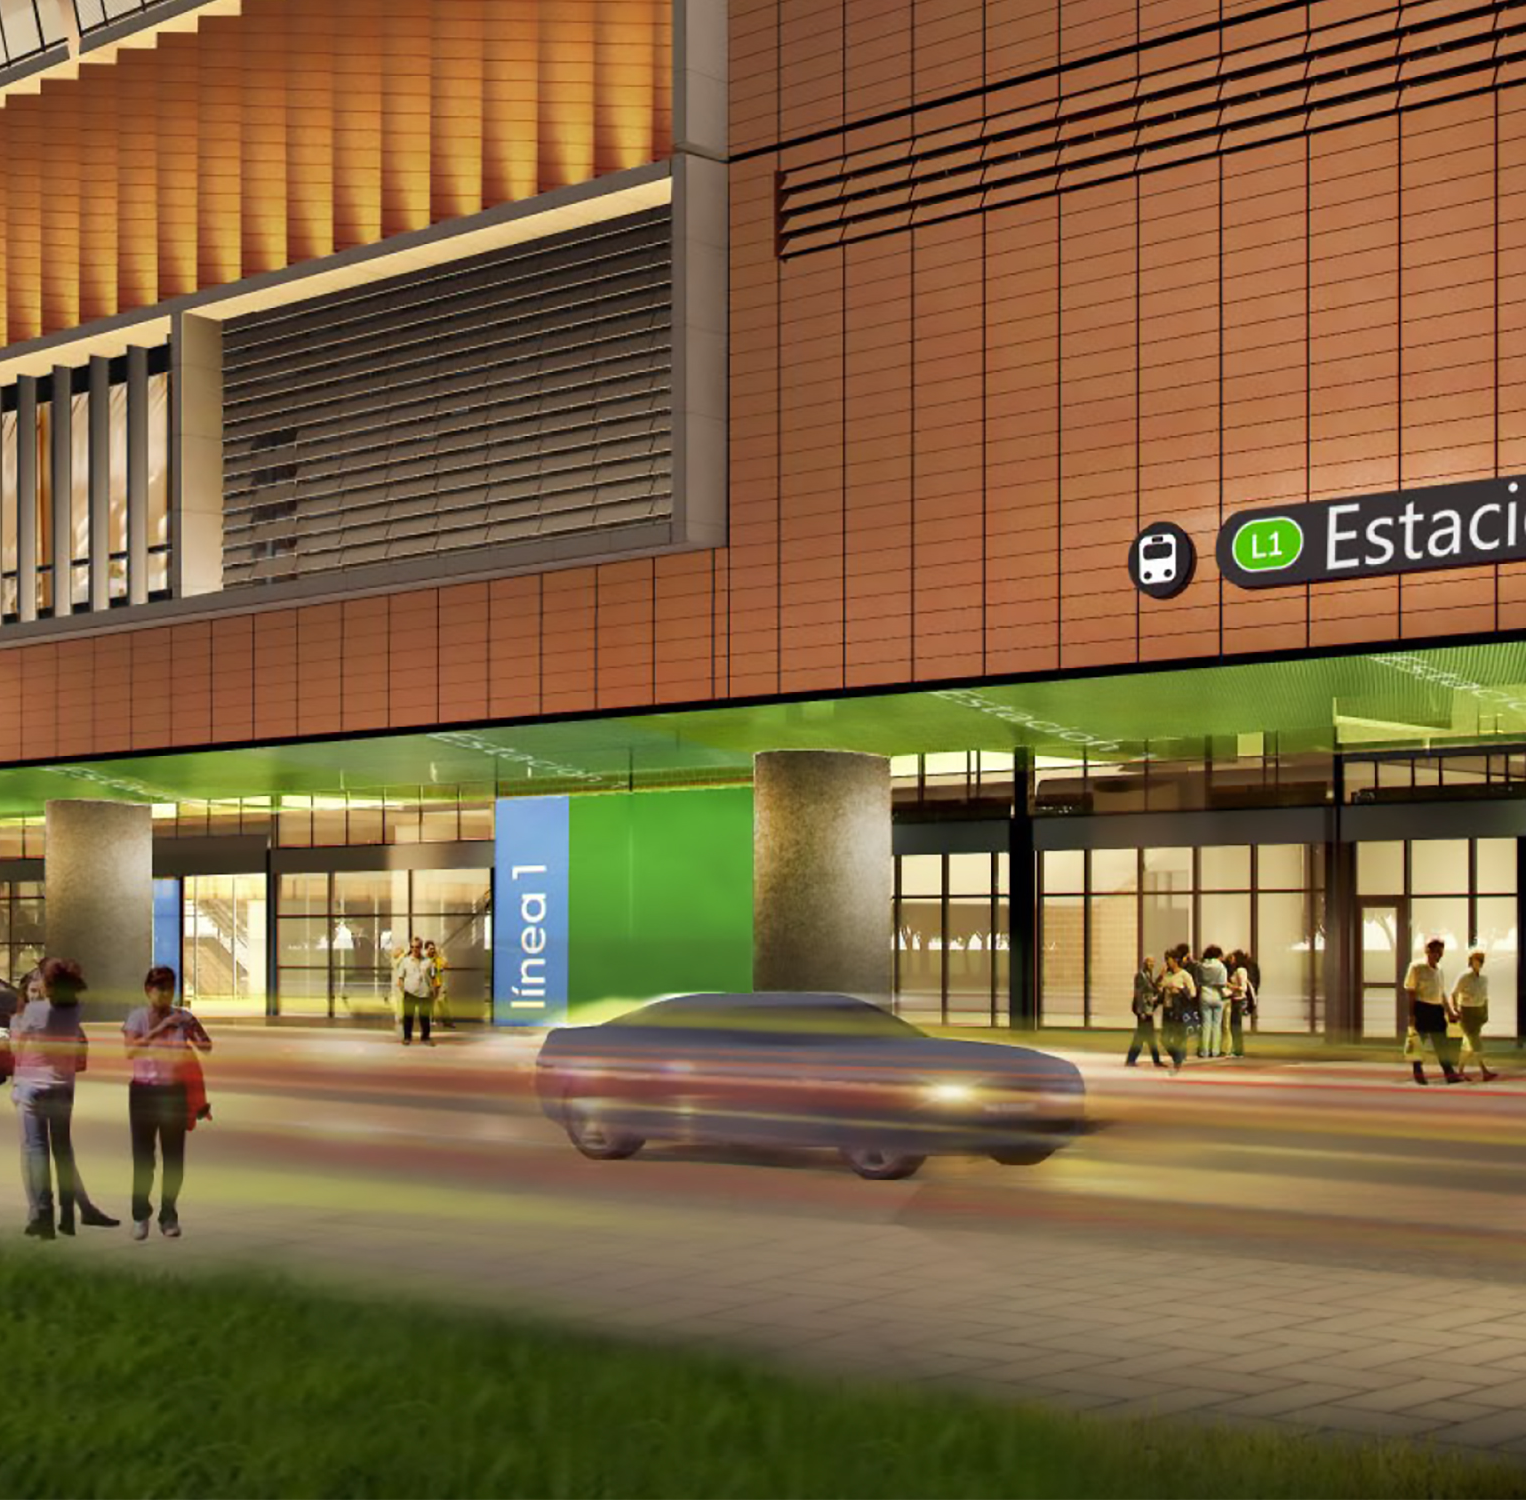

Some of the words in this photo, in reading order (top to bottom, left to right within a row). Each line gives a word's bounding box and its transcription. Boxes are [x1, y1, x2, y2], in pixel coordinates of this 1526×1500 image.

[1251, 530, 1283, 559] L1
[511, 863, 548, 881] 1
[510, 892, 547, 1009] línea
